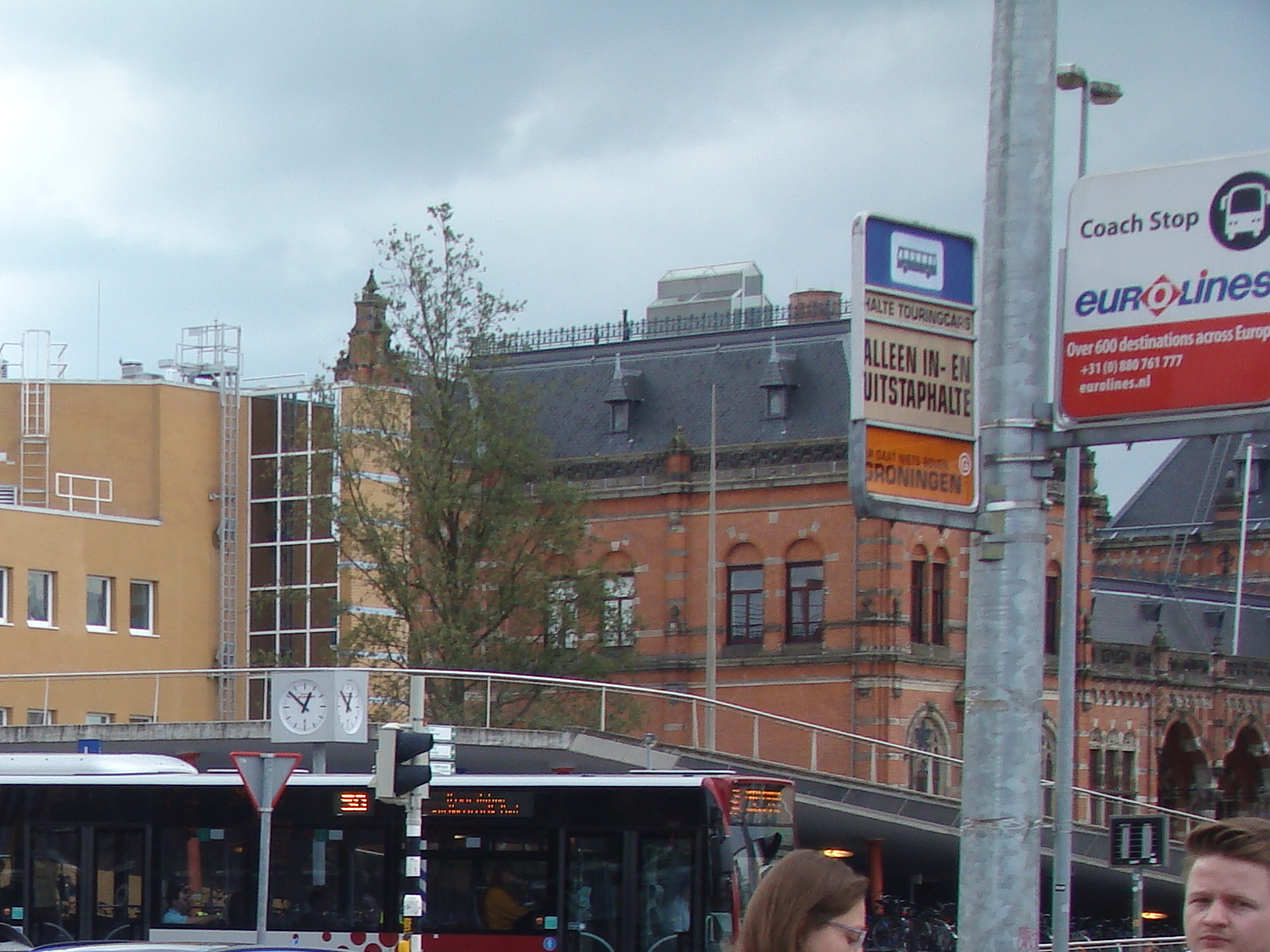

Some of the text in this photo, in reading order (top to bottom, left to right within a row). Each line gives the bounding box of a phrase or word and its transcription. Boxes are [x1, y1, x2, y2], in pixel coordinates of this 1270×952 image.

[1080, 210, 1200, 239] Coach Stop
[1066, 341, 1094, 358] Over
[1095, 337, 1117, 355] 600
[1118, 330, 1194, 353] destinations
[1195, 328, 1234, 345] across
[864, 337, 971, 384] ALLEEN IN- EN
[1080, 362, 1101, 376] +31
[1102, 359, 1118, 375] (0)
[1141, 355, 1161, 370] 761
[1163, 353, 1184, 368] 777
[864, 371, 971, 418] UITSTAPHALTE
[1078, 373, 1152, 394] eurolines.nl
